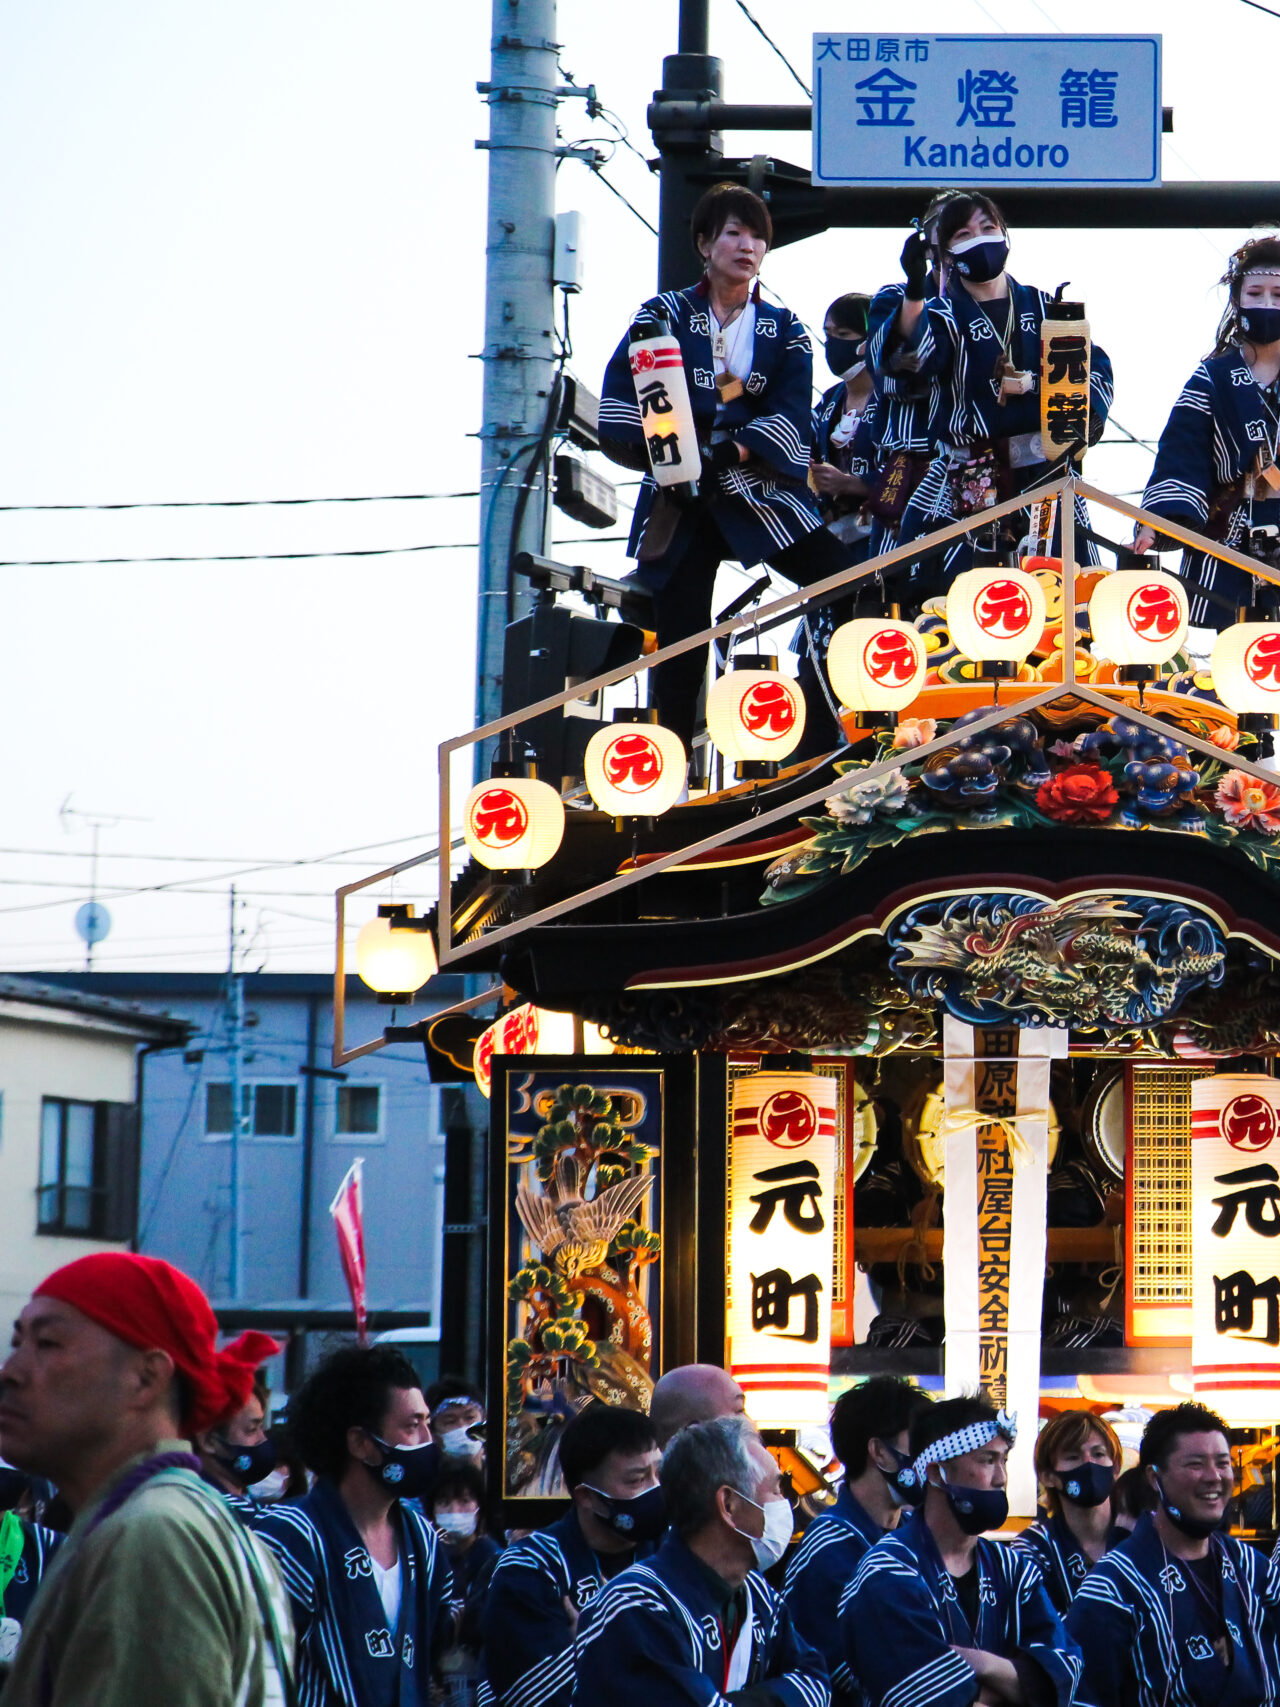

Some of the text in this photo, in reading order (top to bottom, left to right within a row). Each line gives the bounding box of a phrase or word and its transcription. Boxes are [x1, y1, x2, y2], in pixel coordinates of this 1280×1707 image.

[816, 37, 930, 63] 大田原市
[854, 66, 1120, 129] 金燈籠
[903, 135, 1070, 169] Kanadoro
[638, 380, 682, 467] 元町
[975, 581, 1030, 637] 元
[1128, 586, 1180, 640] 元
[865, 629, 918, 685] 元
[742, 681, 796, 738] 元
[605, 735, 662, 791] 元
[472, 790, 527, 847] 元
[748, 1159, 826, 1344] 元町
